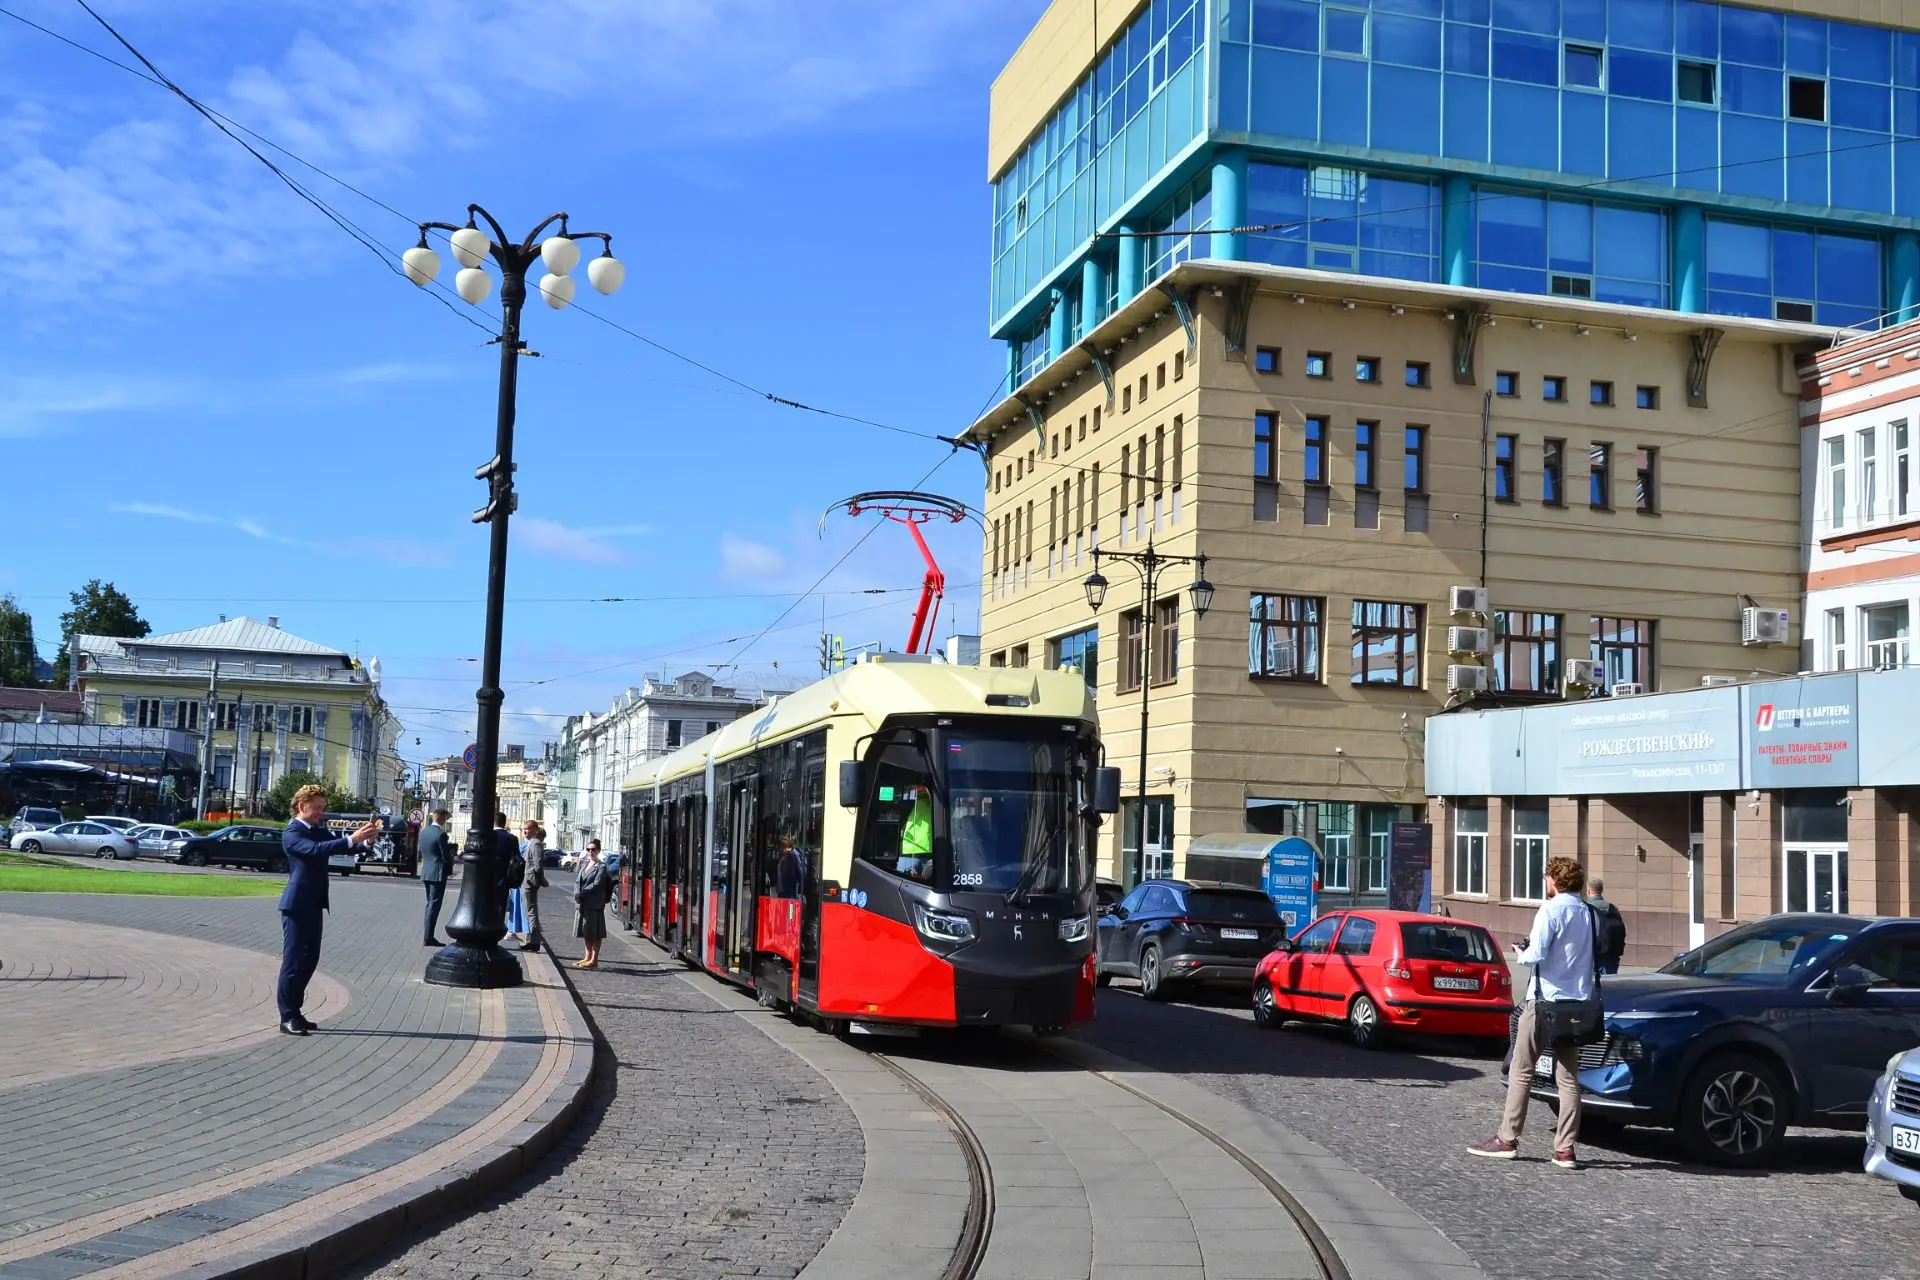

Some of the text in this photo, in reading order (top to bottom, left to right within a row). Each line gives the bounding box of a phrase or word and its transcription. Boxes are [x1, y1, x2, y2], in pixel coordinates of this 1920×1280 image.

[1788, 742, 1822, 753] ТОВАРНЫЕ
[1771, 754, 1832, 765] ПАТЕНТНЫЕ СПОРЫ
[952, 873, 983, 886] 2858
